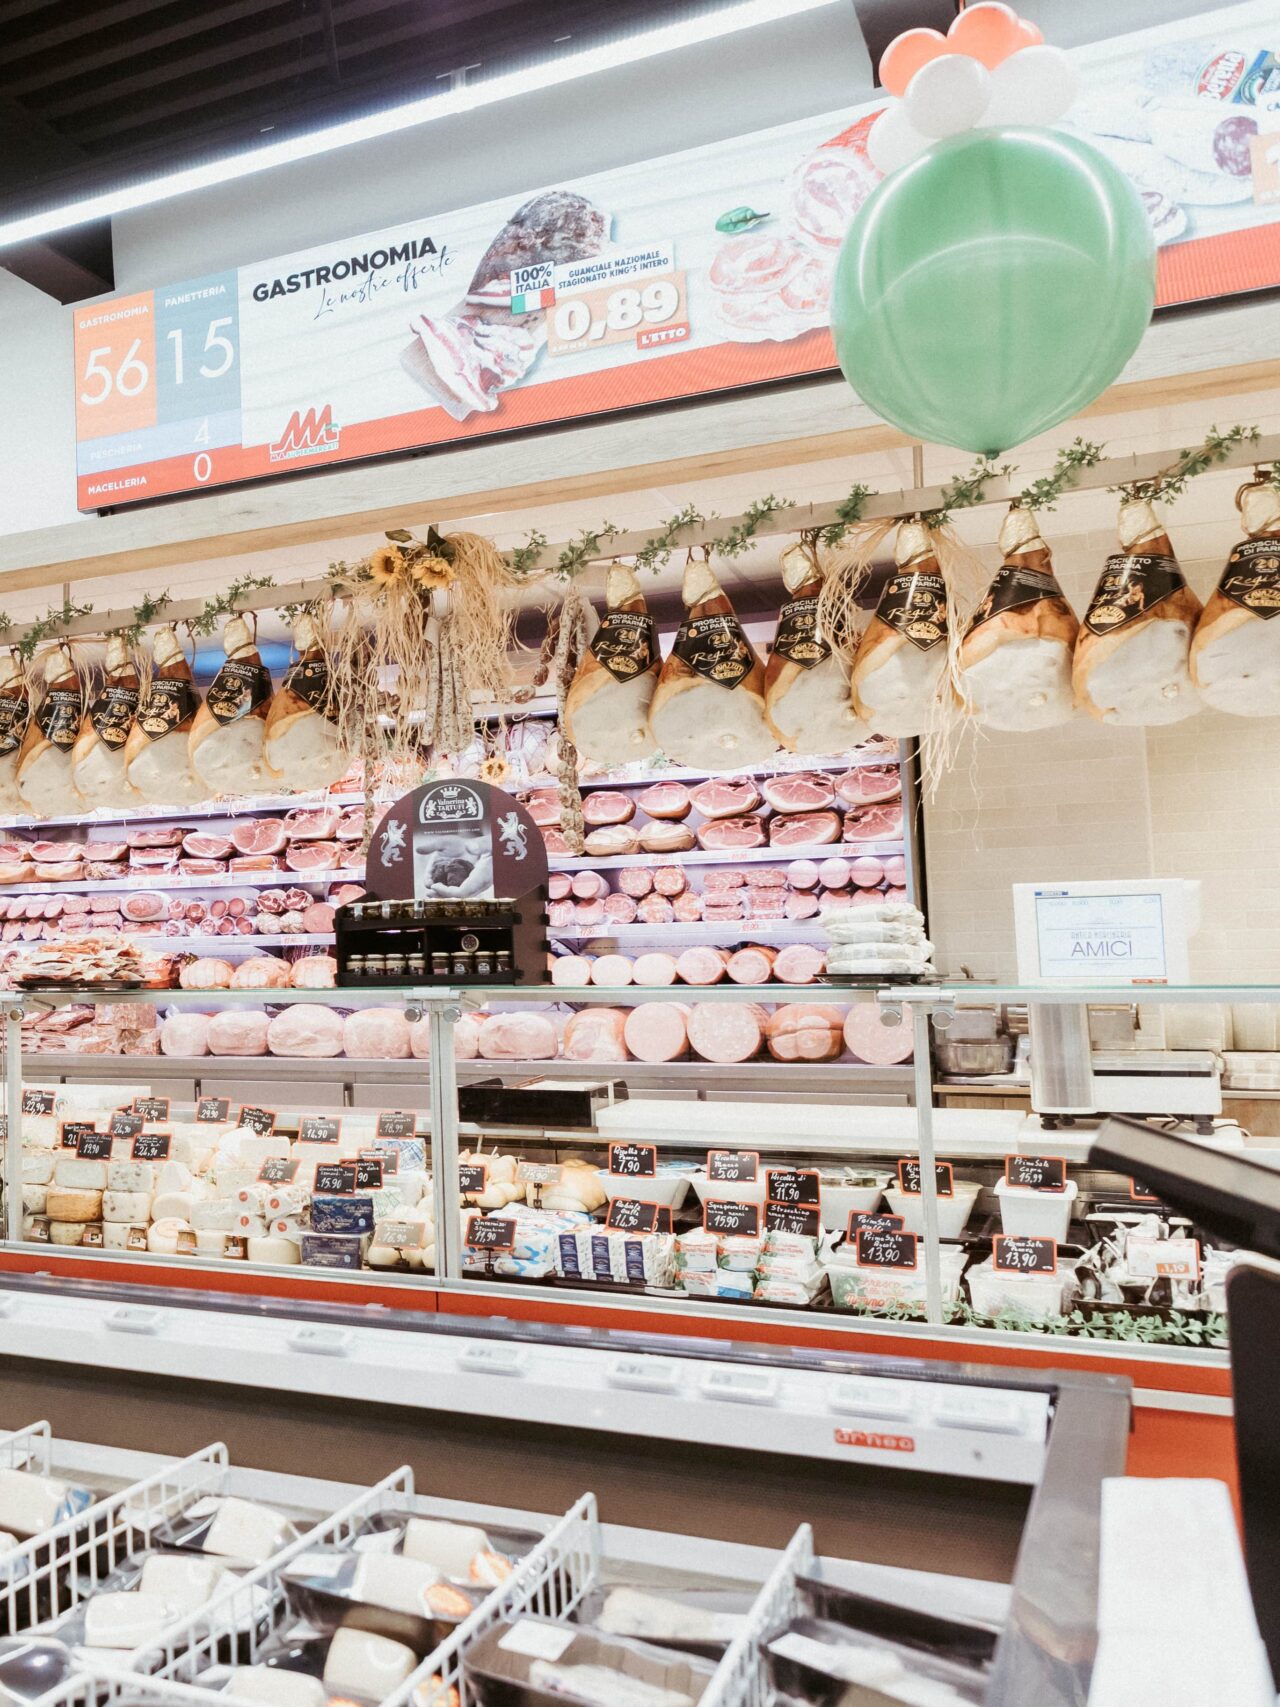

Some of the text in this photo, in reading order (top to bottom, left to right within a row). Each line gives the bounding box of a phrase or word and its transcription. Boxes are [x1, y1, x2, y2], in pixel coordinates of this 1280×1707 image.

[252, 237, 437, 302] GASTRONOMIA
[568, 250, 660, 278] GUANCIALE NAZIONALE
[513, 263, 552, 284] 100%
[558, 257, 669, 290] STAGIONATO KING'S INTERO
[314, 245, 458, 320] Le nostre offerte
[515, 279, 550, 295] ITALIA
[164, 285, 226, 307] PANETTERIA
[79, 305, 149, 329] GASTRONOMIA
[554, 281, 680, 342] 0,89
[640, 327, 687, 345] L'ETTO
[167, 316, 235, 385] 15
[80, 338, 149, 406] 56
[193, 416, 210, 445] 4
[193, 452, 213, 482] 0
[87, 475, 147, 496] MACELLERIA
[912, 592, 933, 603] 20
[793, 604, 818, 612] PARM
[607, 613, 653, 625] PROSCIUTTO
[621, 619, 648, 628] PARMA
[709, 622, 736, 630] PARMA
[618, 629, 636, 639] 20
[711, 634, 731, 645] 20
[594, 640, 635, 658] Regio
[690, 647, 735, 671] Regio
[231, 668, 253, 677] PARMA
[48, 691, 81, 699] PROSCIUTT
[60, 695, 81, 703] PARMA
[106, 687, 140, 697] PROSCIUTT
[115, 692, 137, 701] PARMA
[1071, 940, 1133, 957] AMICI
[618, 1159, 640, 1173] 7,90
[774, 1180, 798, 1189] Capra
[797, 1174, 807, 1182] di
[775, 1188, 800, 1201] 11,90
[866, 1247, 901, 1263] 13,90
[1004, 1252, 1038, 1268] 13,90
